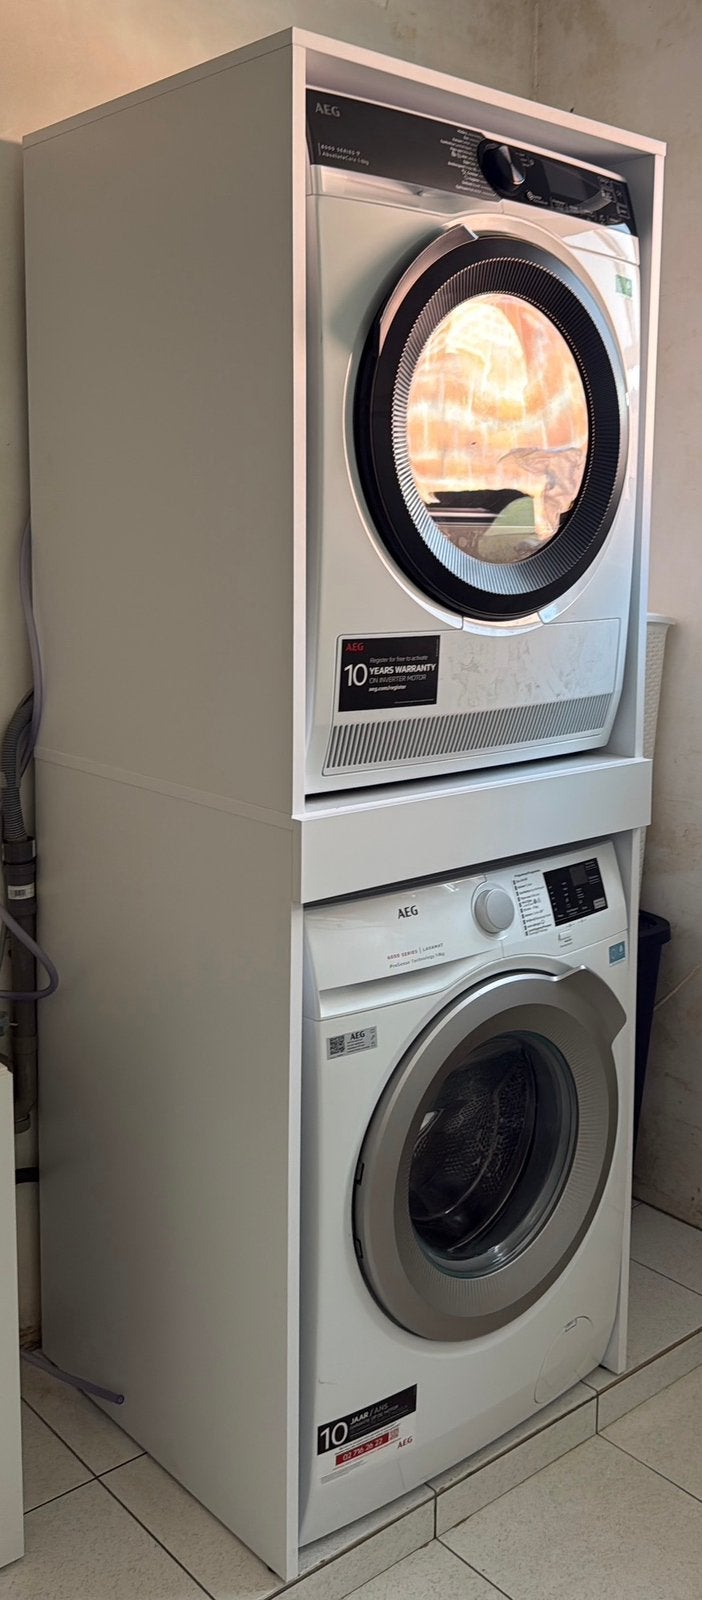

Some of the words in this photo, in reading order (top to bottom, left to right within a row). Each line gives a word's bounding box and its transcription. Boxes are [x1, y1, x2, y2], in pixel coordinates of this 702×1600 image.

[315, 102, 340, 117] AEG
[345, 642, 364, 652] AEG
[369, 656, 388, 664] Register
[343, 663, 368, 687] 10
[369, 666, 394, 675] YEARS
[395, 663, 436, 674] WARRANTY
[379, 675, 406, 683] INVERTER
[398, 905, 418, 919] AEG
[401, 949, 418, 957] SERIES
[350, 1030, 365, 1040] AEG
[350, 1411, 369, 1425] JAAR
[320, 1421, 348, 1450] 10
[397, 1436, 413, 1449] AEG
[342, 1452, 352, 1461] 02
[365, 1442, 374, 1451] 26
[374, 1438, 383, 1447] 22
